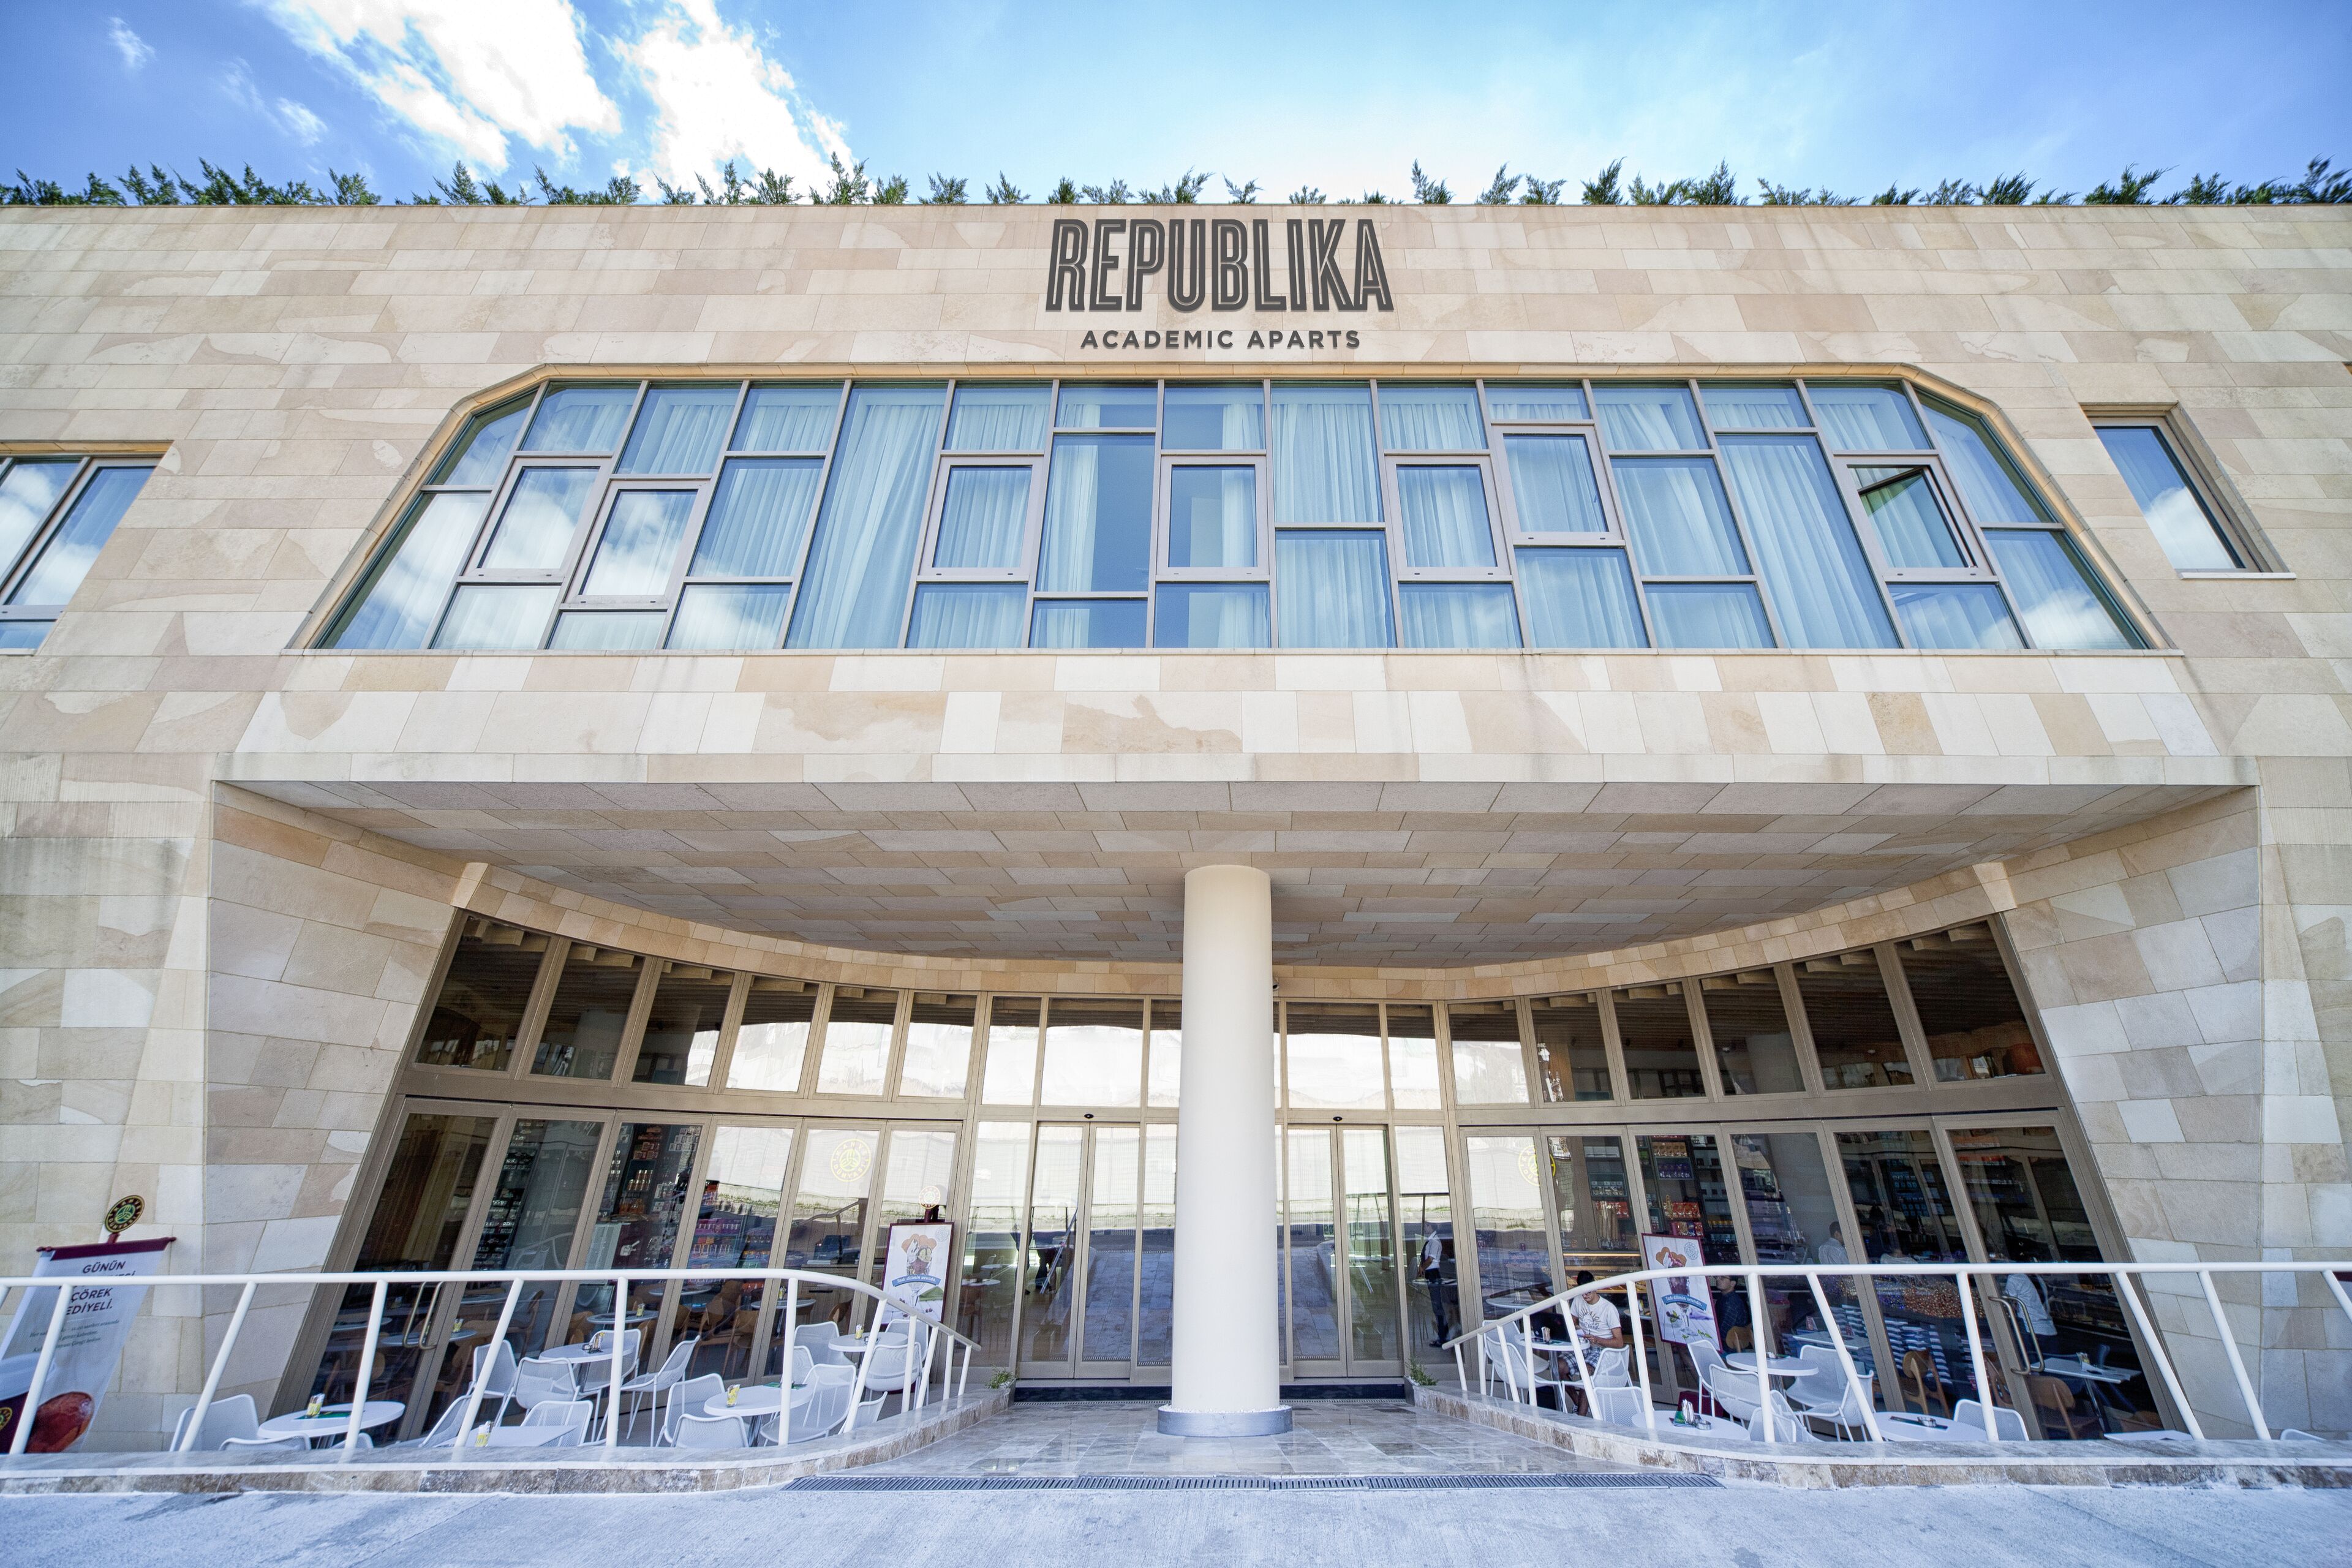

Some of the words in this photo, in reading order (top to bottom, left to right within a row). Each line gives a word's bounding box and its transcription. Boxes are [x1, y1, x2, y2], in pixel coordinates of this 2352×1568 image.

[1046, 219, 1394, 311] REPUBLIKA
[1080, 330, 1234, 349] ACADEMIC
[1248, 330, 1360, 349] APARTS
[83, 1260, 126, 1273] GÜNÜN
[71, 1288, 113, 1303] ÇÖREK
